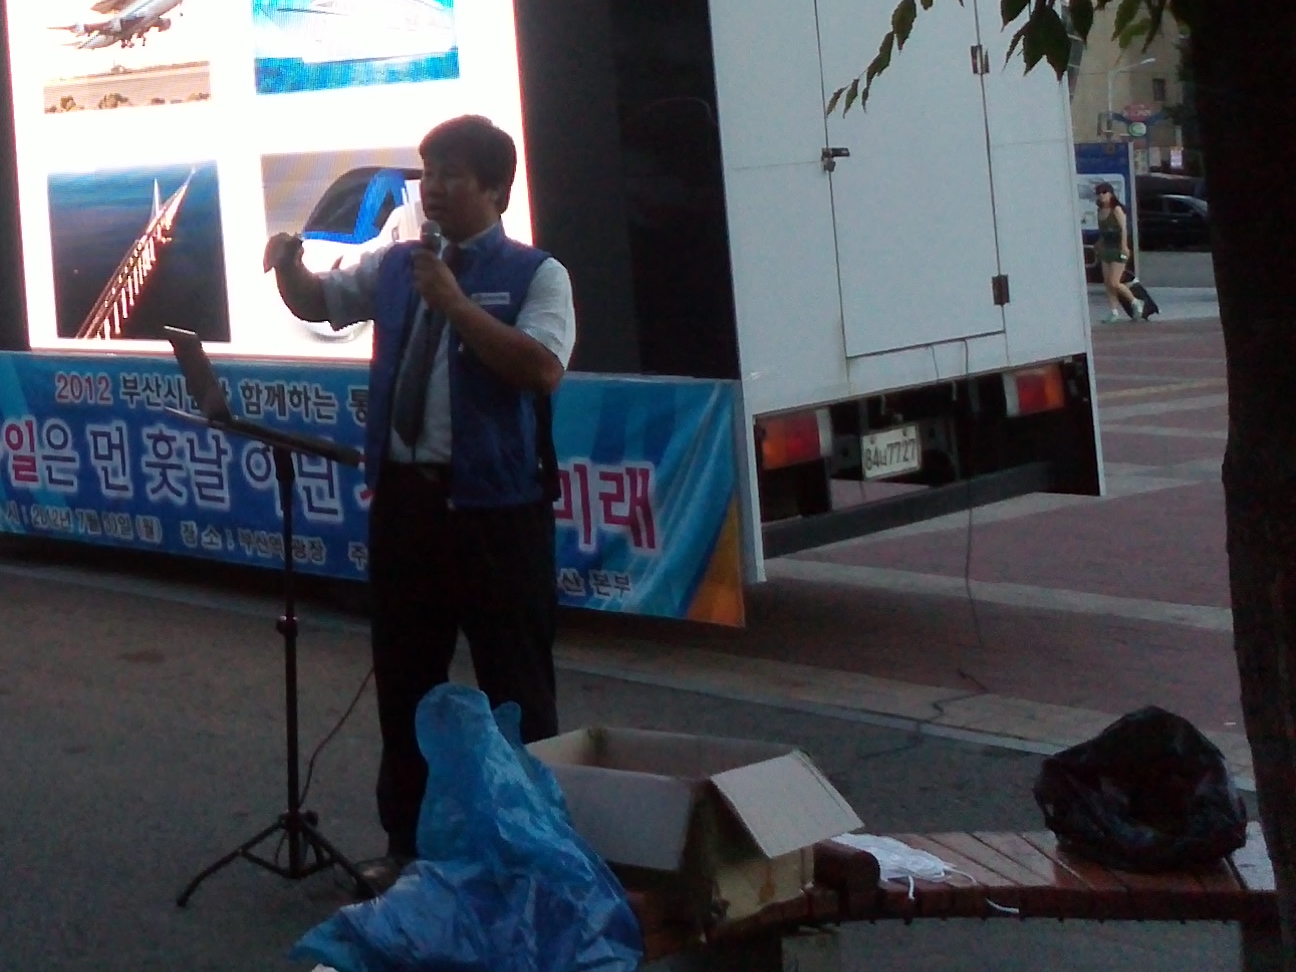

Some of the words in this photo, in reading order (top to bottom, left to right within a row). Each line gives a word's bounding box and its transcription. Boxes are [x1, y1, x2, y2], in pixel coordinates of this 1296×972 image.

[56, 374, 111, 402] 2012
[120, 375, 228, 408] 부산시
[240, 382, 336, 421] 함께하는
[89, 426, 130, 492] 먼
[144, 427, 229, 504] 훗날
[592, 571, 631, 597] 본부
